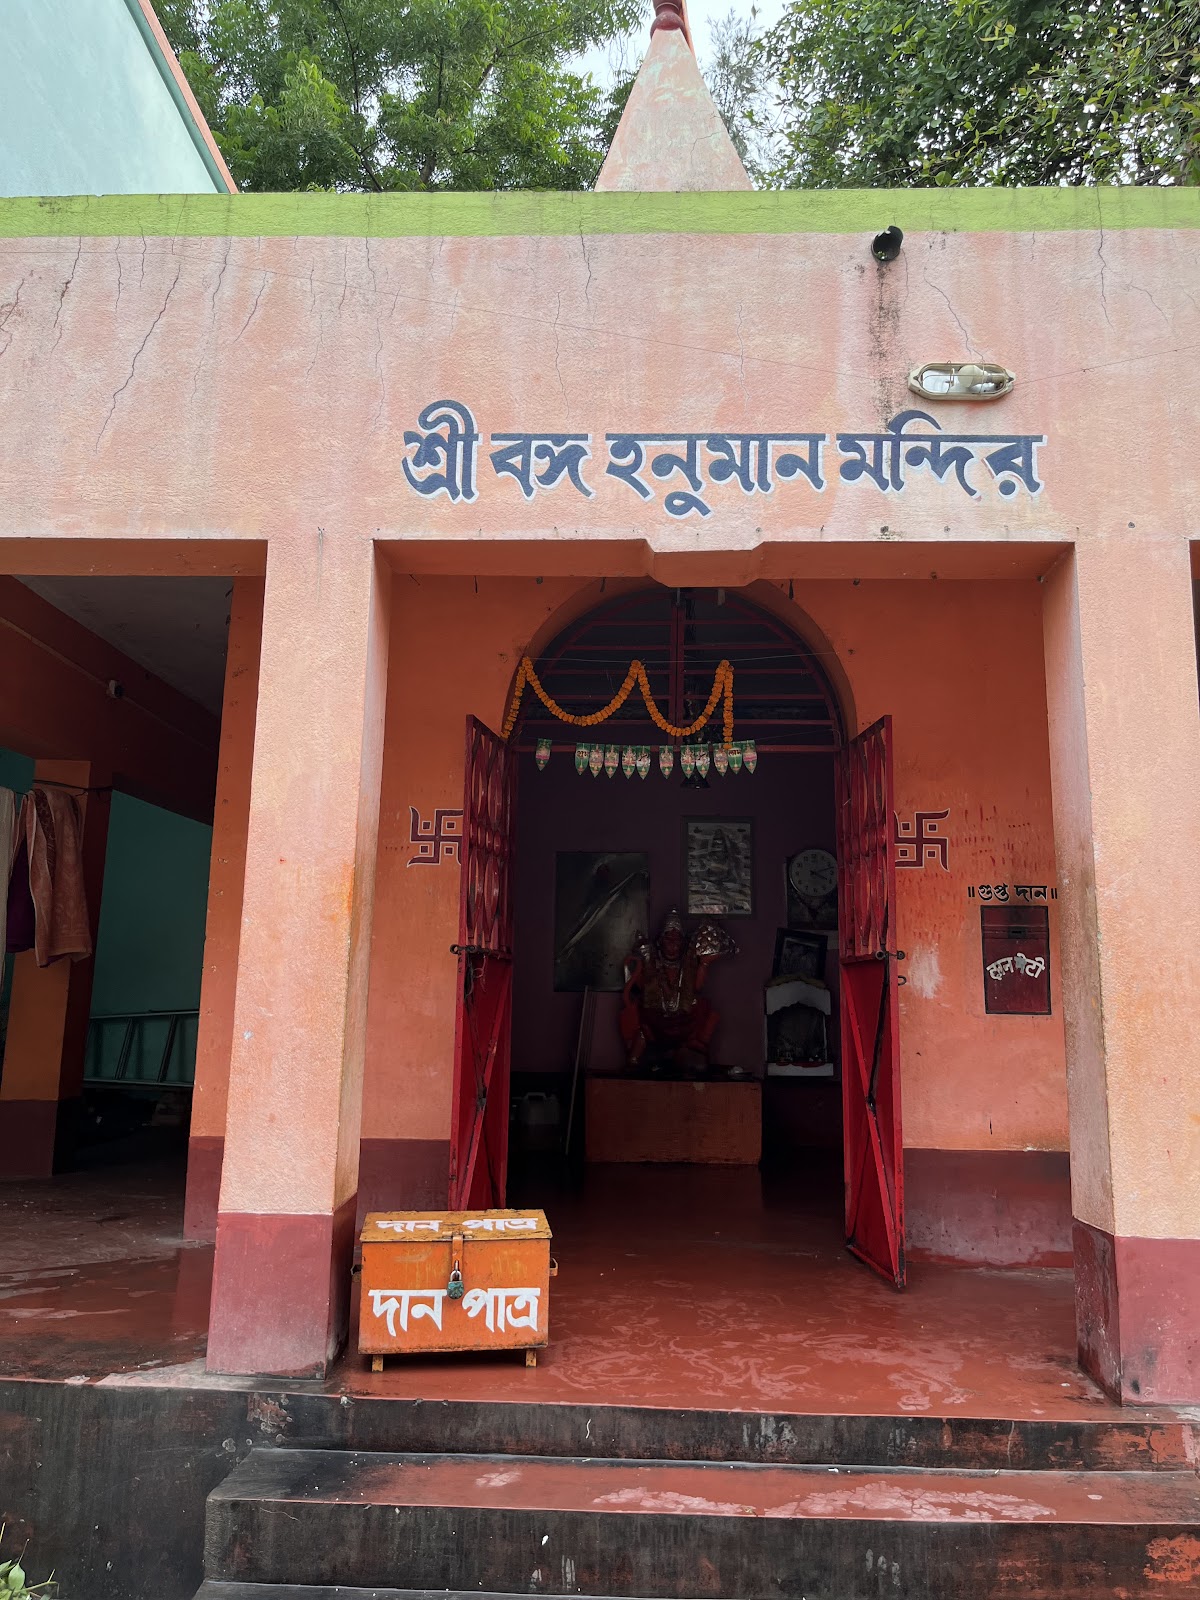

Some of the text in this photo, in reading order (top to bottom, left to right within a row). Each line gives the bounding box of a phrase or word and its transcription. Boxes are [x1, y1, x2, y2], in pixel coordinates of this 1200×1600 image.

[402, 399, 1047, 519] শ্রী বঙ্গ হনুমান মন্দির
[977, 882, 1010, 902] গুপ্ত
[1013, 884, 1048, 902] দান
[376, 1217, 539, 1233] দান পাত্র
[367, 1287, 541, 1337] দান পাত্র
